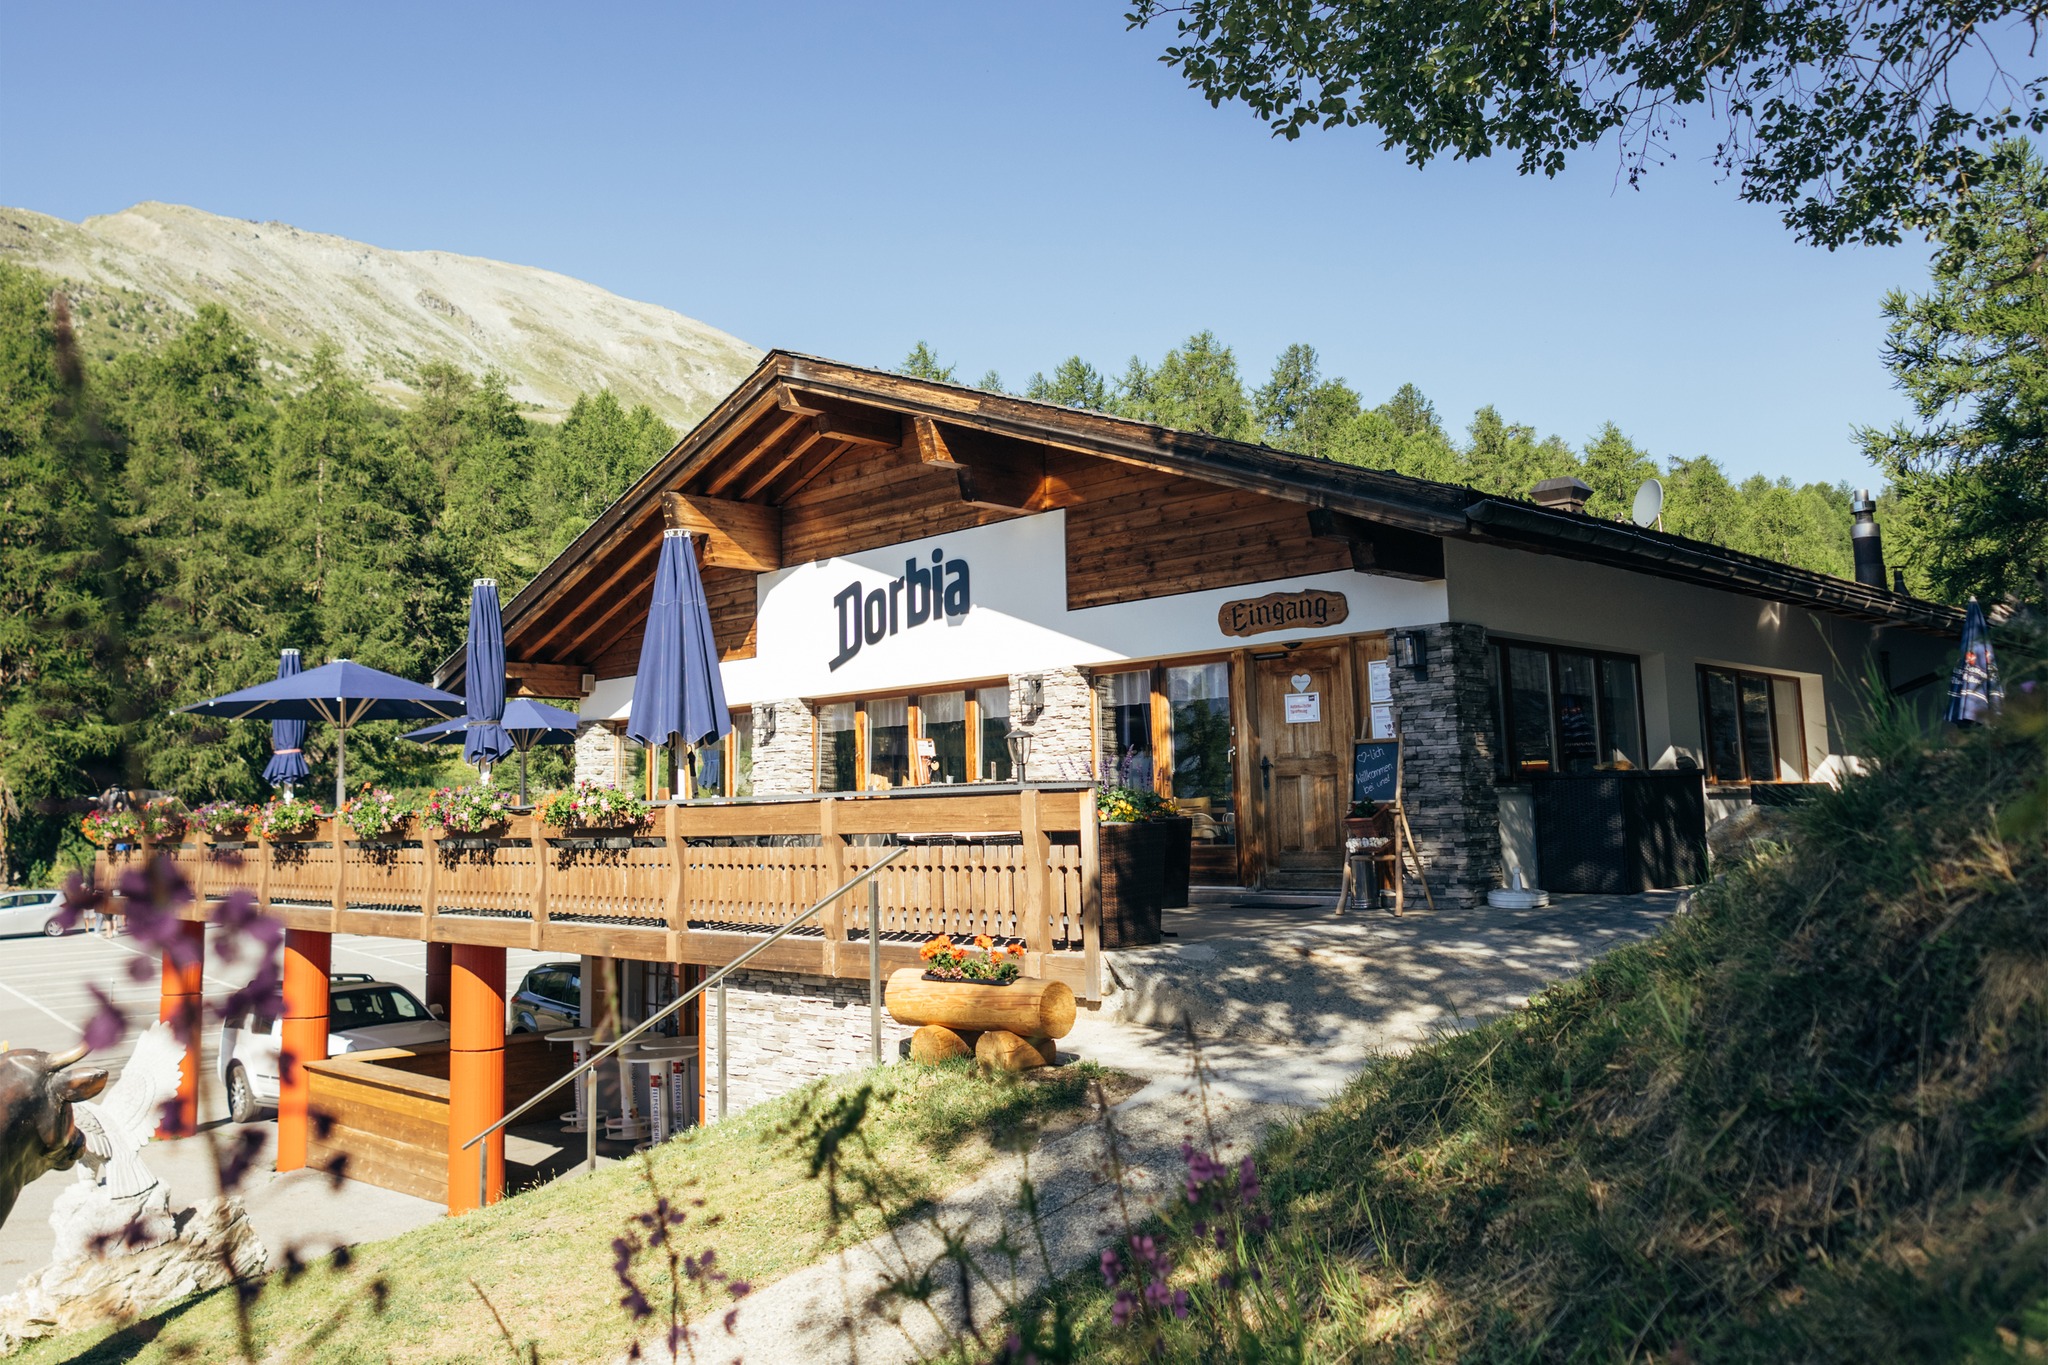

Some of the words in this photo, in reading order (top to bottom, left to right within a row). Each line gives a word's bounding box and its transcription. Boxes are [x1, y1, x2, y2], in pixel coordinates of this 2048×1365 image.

[828, 547, 970, 673] Dorbia
[1231, 597, 1328, 631] Eingang
[1355, 763, 1393, 784] Willkommen
[1363, 783, 1374, 794] bei
